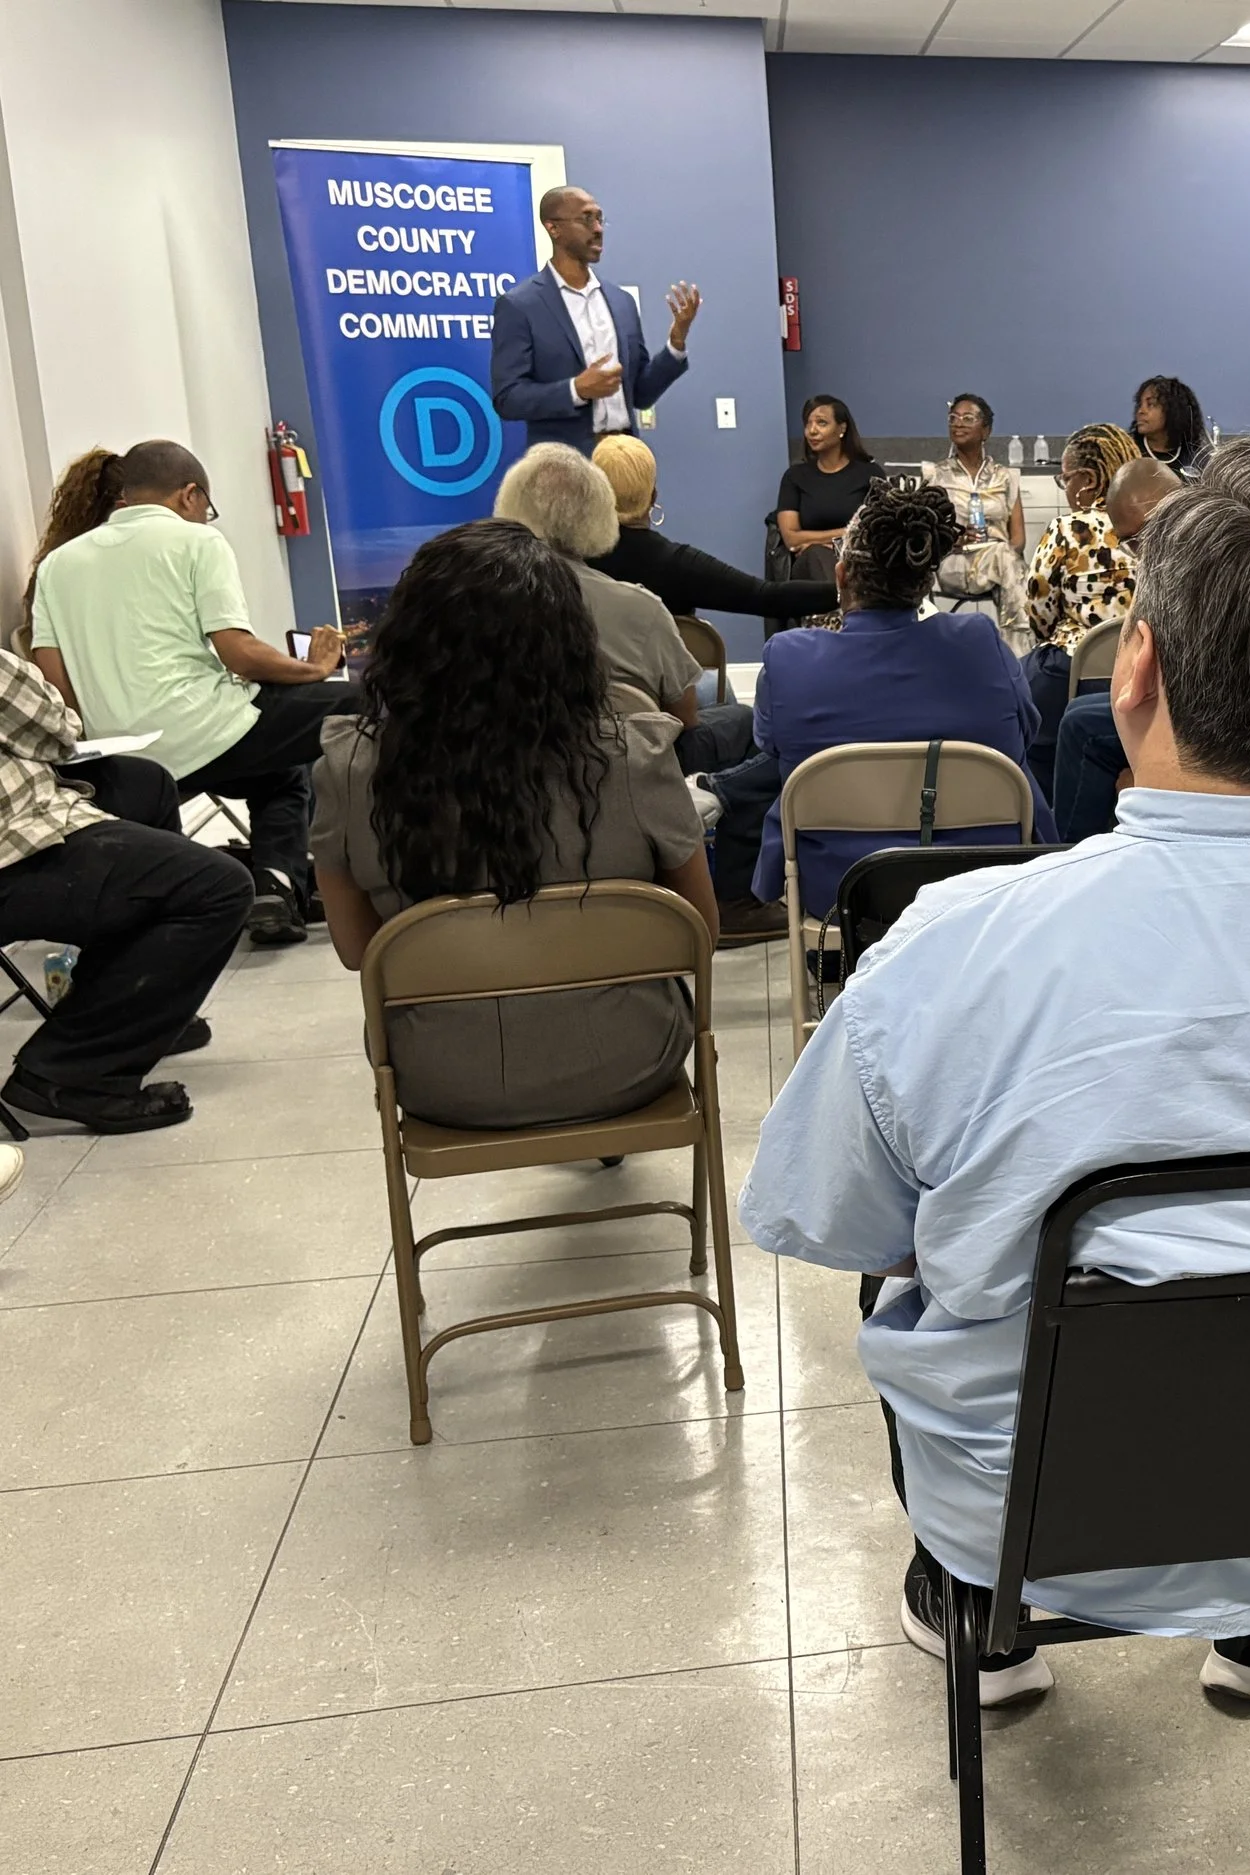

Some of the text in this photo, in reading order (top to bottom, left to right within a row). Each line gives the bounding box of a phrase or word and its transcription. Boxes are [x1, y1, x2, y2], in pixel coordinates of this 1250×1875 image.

[327, 179, 494, 213] MUSCOGEE
[357, 225, 476, 255] COUNTY
[326, 268, 516, 297] DEMOCRATIC
[785, 281, 795, 316] SDS
[339, 312, 495, 339] COMMITTE
[414, 397, 475, 467] D
